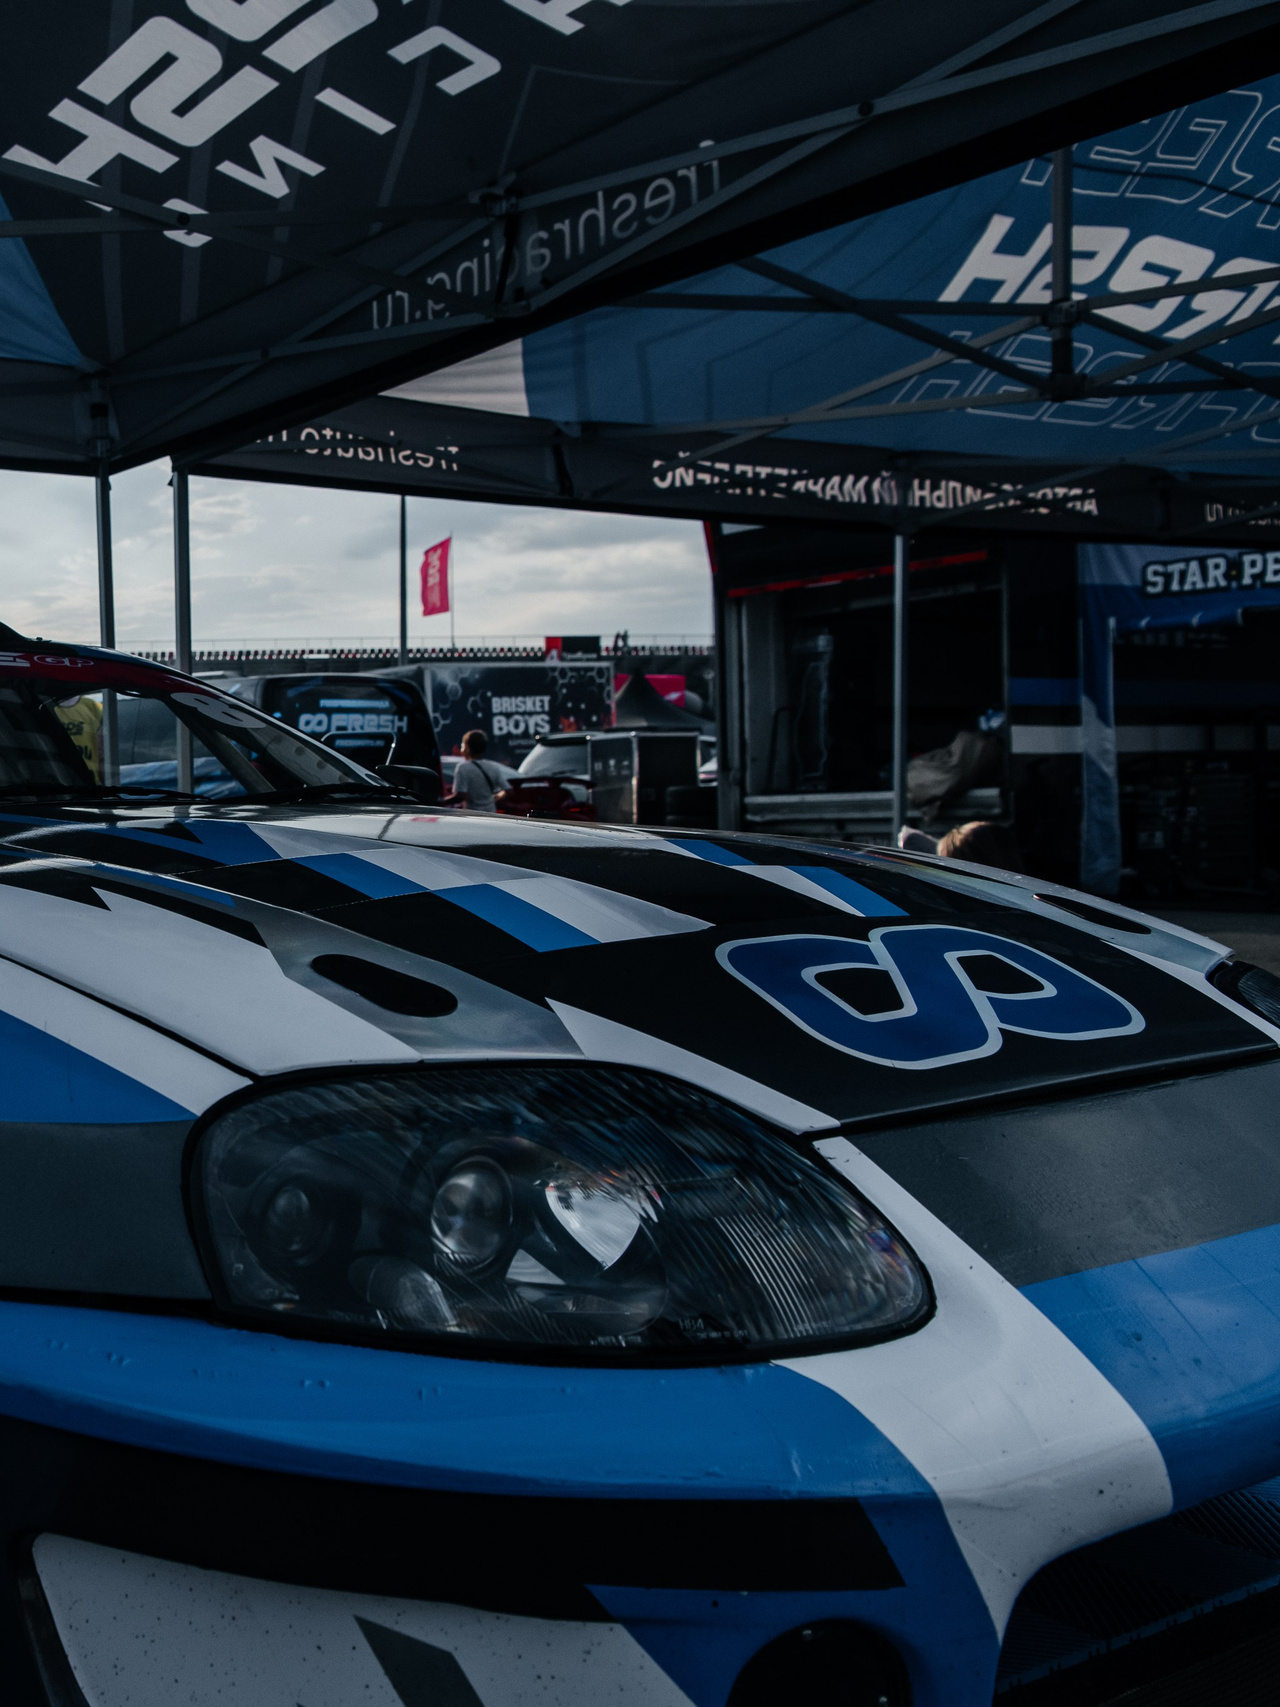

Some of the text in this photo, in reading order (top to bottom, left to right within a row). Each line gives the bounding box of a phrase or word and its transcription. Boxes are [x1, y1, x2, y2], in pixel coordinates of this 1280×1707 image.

[1145, 555, 1229, 595] STAR
[491, 695, 551, 714] BRISKET
[330, 713, 409, 734] FRESH
[492, 713, 551, 736] BOYS
